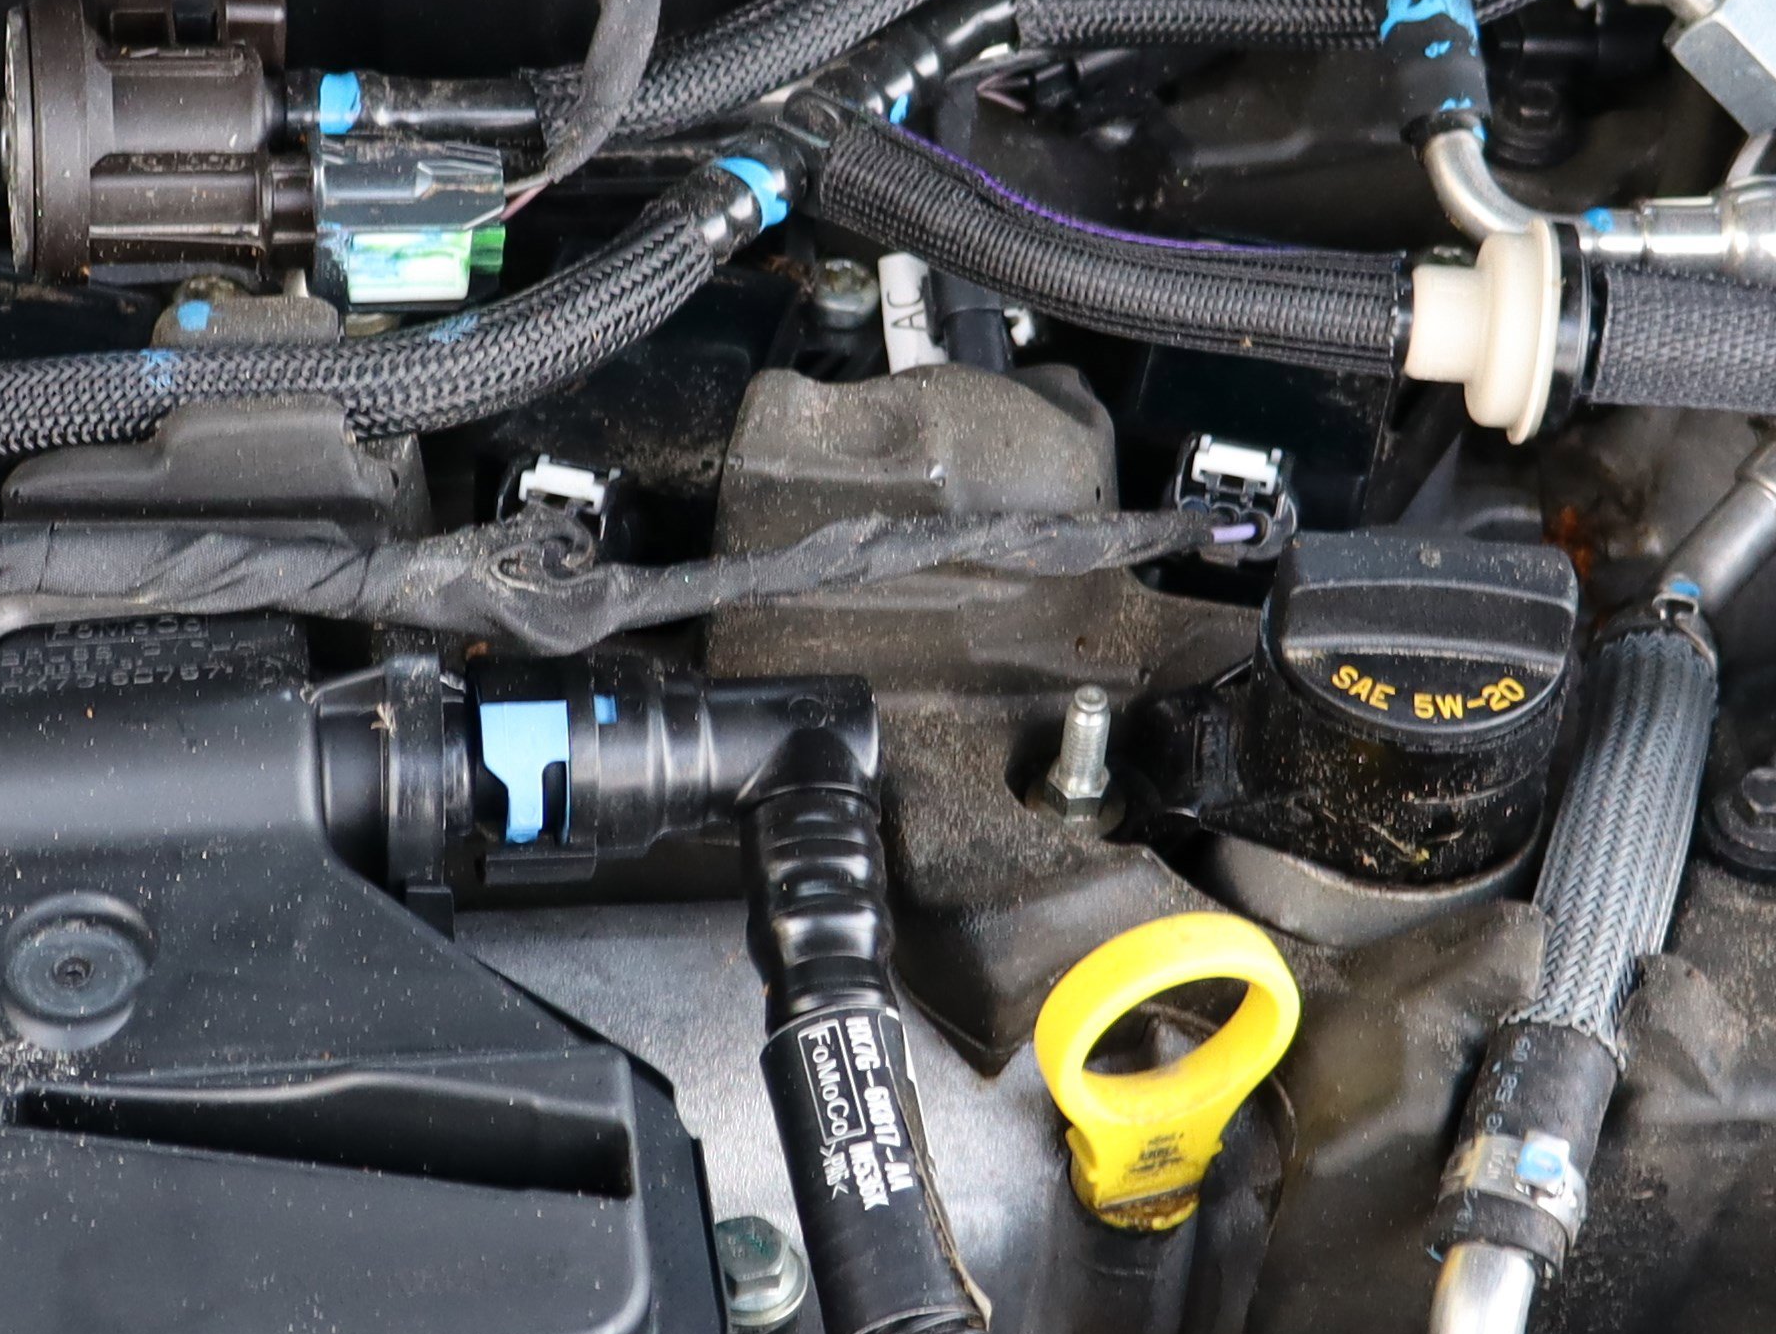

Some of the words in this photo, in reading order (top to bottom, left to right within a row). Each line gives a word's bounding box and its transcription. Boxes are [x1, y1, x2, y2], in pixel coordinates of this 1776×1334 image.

[1331, 664, 1397, 711] SAE
[1413, 676, 1526, 720] 5W-20
[807, 1024, 852, 1138] FoMoCo
